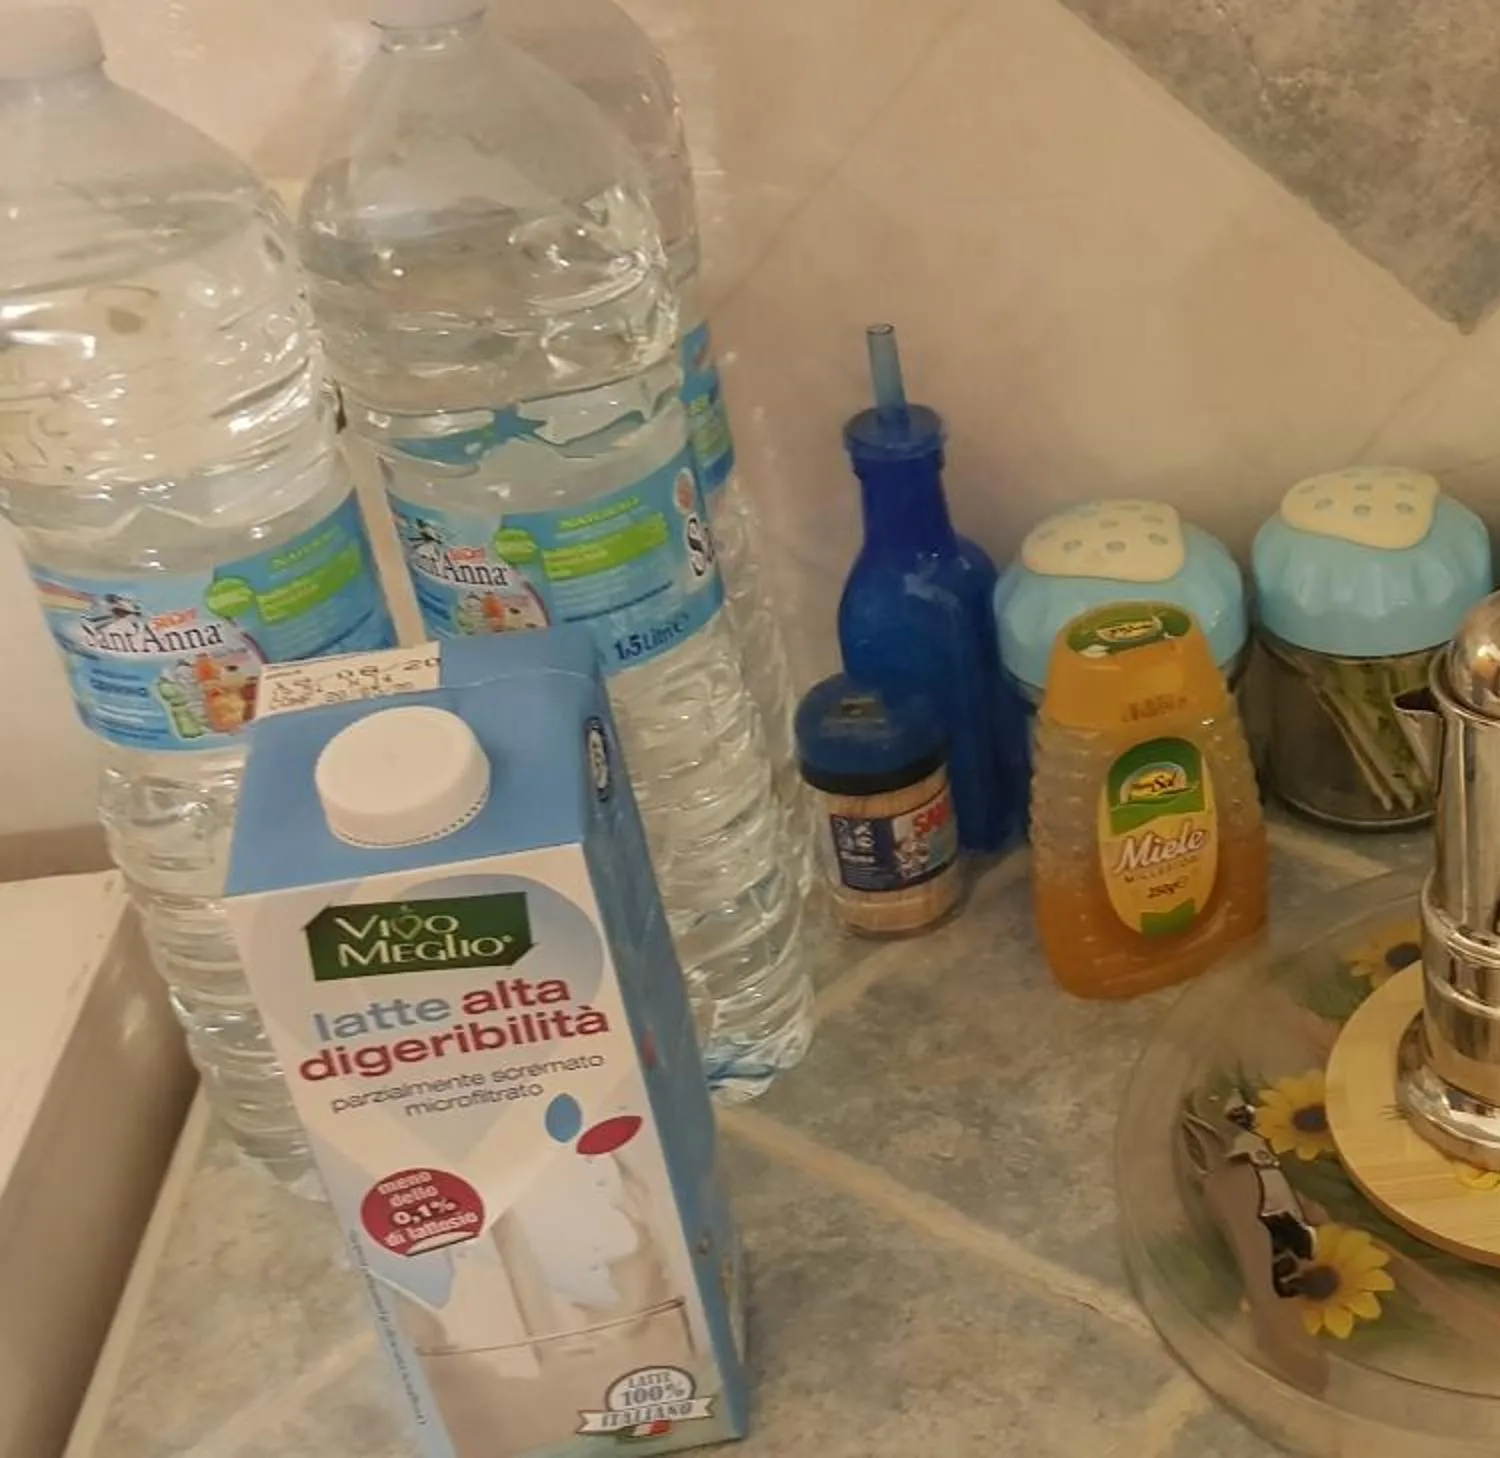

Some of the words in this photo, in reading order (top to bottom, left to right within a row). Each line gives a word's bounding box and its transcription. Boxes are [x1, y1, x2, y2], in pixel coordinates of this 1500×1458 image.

[1112, 817, 1209, 875] Miele
[338, 934, 510, 968] MEGLIO
[313, 997, 451, 1042] latte
[461, 975, 572, 1016] alta
[298, 1005, 610, 1082] digeribilità
[330, 1070, 486, 1114] parzialmente
[490, 1052, 606, 1084] scremato
[405, 1081, 545, 1118] microfiltrato
[377, 1171, 433, 1195] meno
[388, 1185, 439, 1208] dello
[383, 1229, 407, 1247] di
[405, 1211, 479, 1241] lattosio
[392, 1198, 457, 1226] 0,1%
[621, 1382, 686, 1406] 100%
[627, 1370, 672, 1389] LATTE
[600, 1401, 693, 1427] ITALIANO
